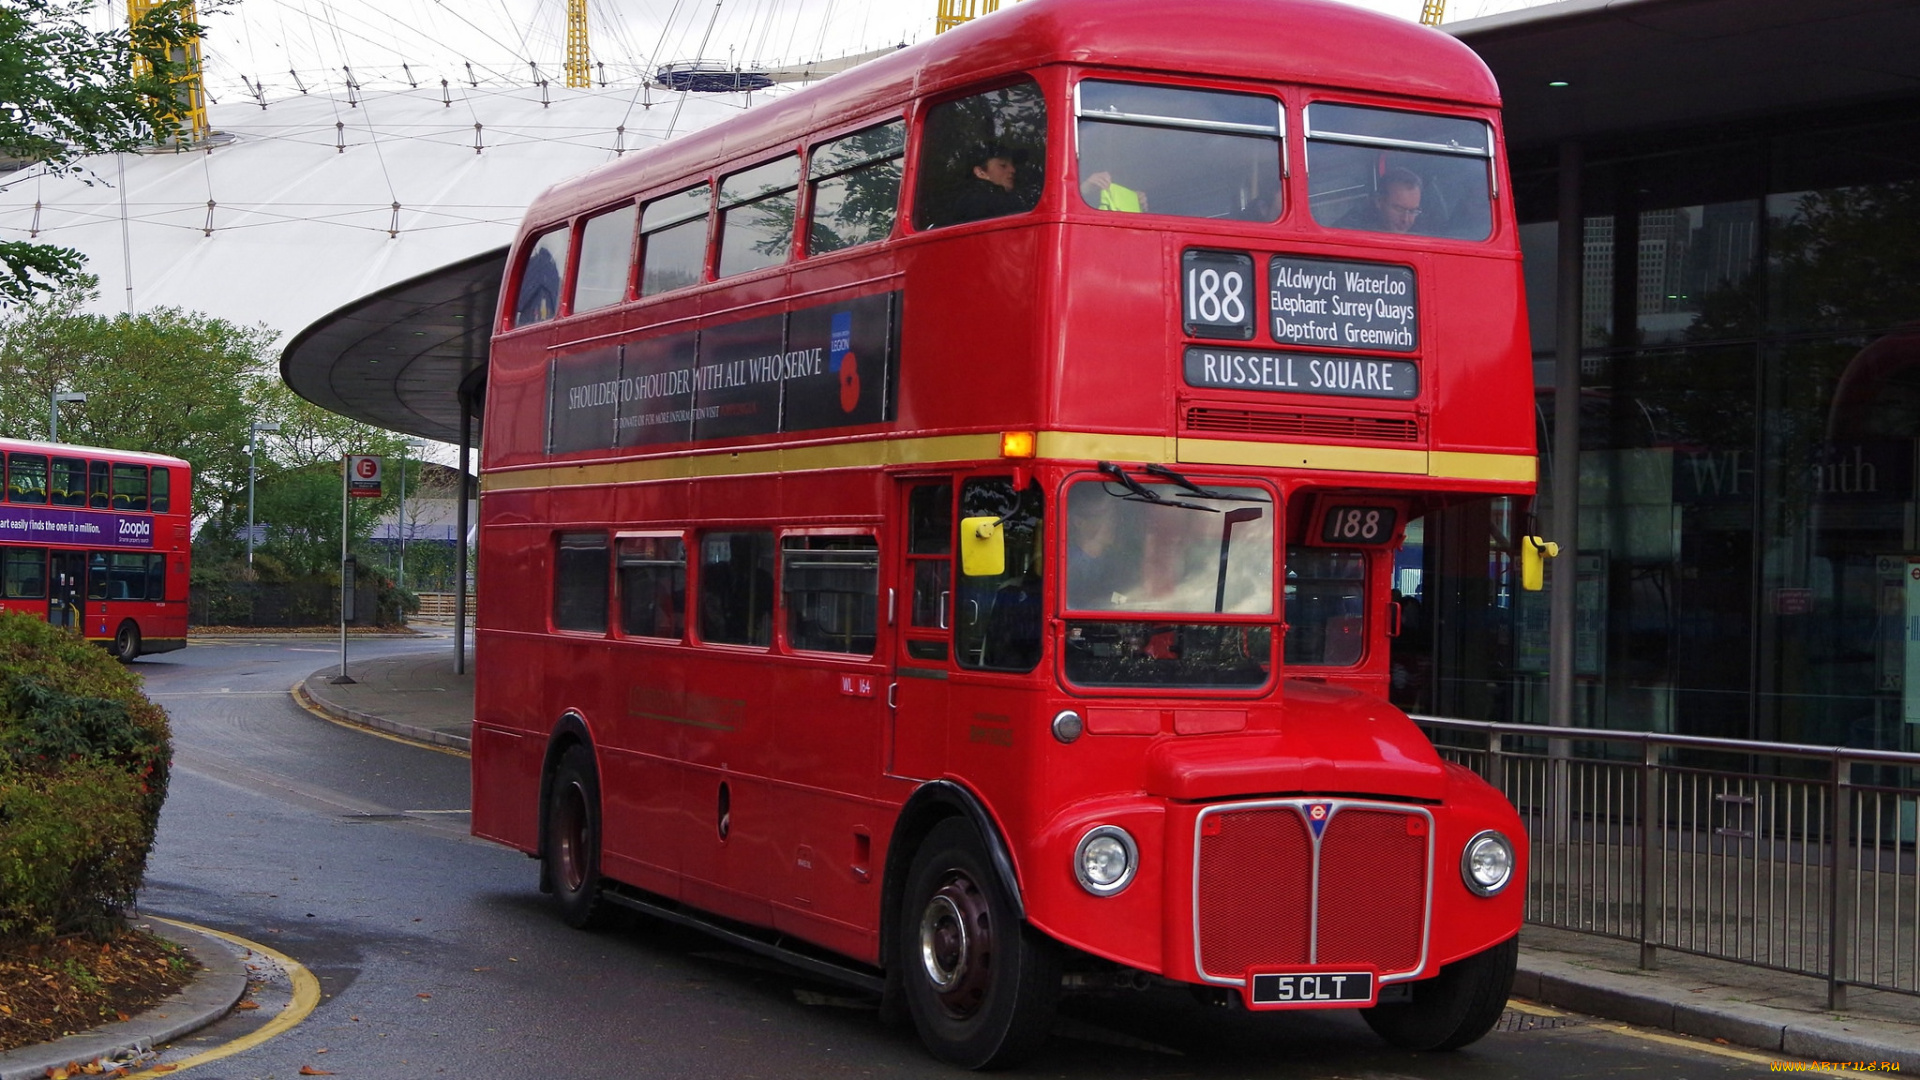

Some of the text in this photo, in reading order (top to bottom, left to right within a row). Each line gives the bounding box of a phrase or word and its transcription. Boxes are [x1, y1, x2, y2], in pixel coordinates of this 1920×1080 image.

[1277, 267, 1406, 295] Aldwych Waterloo
[1189, 268, 1245, 323] 188
[1271, 290, 1414, 325] Elephant Surrey Quays
[831, 338, 849, 352] LEGION
[1276, 317, 1412, 346] Deptford Greenwich
[569, 347, 822, 410] SHOULDER TO SHOULDER WITH ALL WHO SERVE
[1204, 354, 1394, 390] RUSSELL SQUARE
[362, 462, 372, 475] E
[10, 519, 28, 532] easily
[29, 519, 45, 530] finds
[45, 520, 55, 531] the
[56, 523, 67, 532] one
[68, 521, 74, 532] in
[75, 524, 79, 532] a
[79, 522, 101, 533] million.
[119, 519, 150, 537] Zoopla
[1333, 509, 1379, 538] 188
[842, 676, 870, 694] WL 164
[1279, 976, 1347, 1000] 5 CLT
